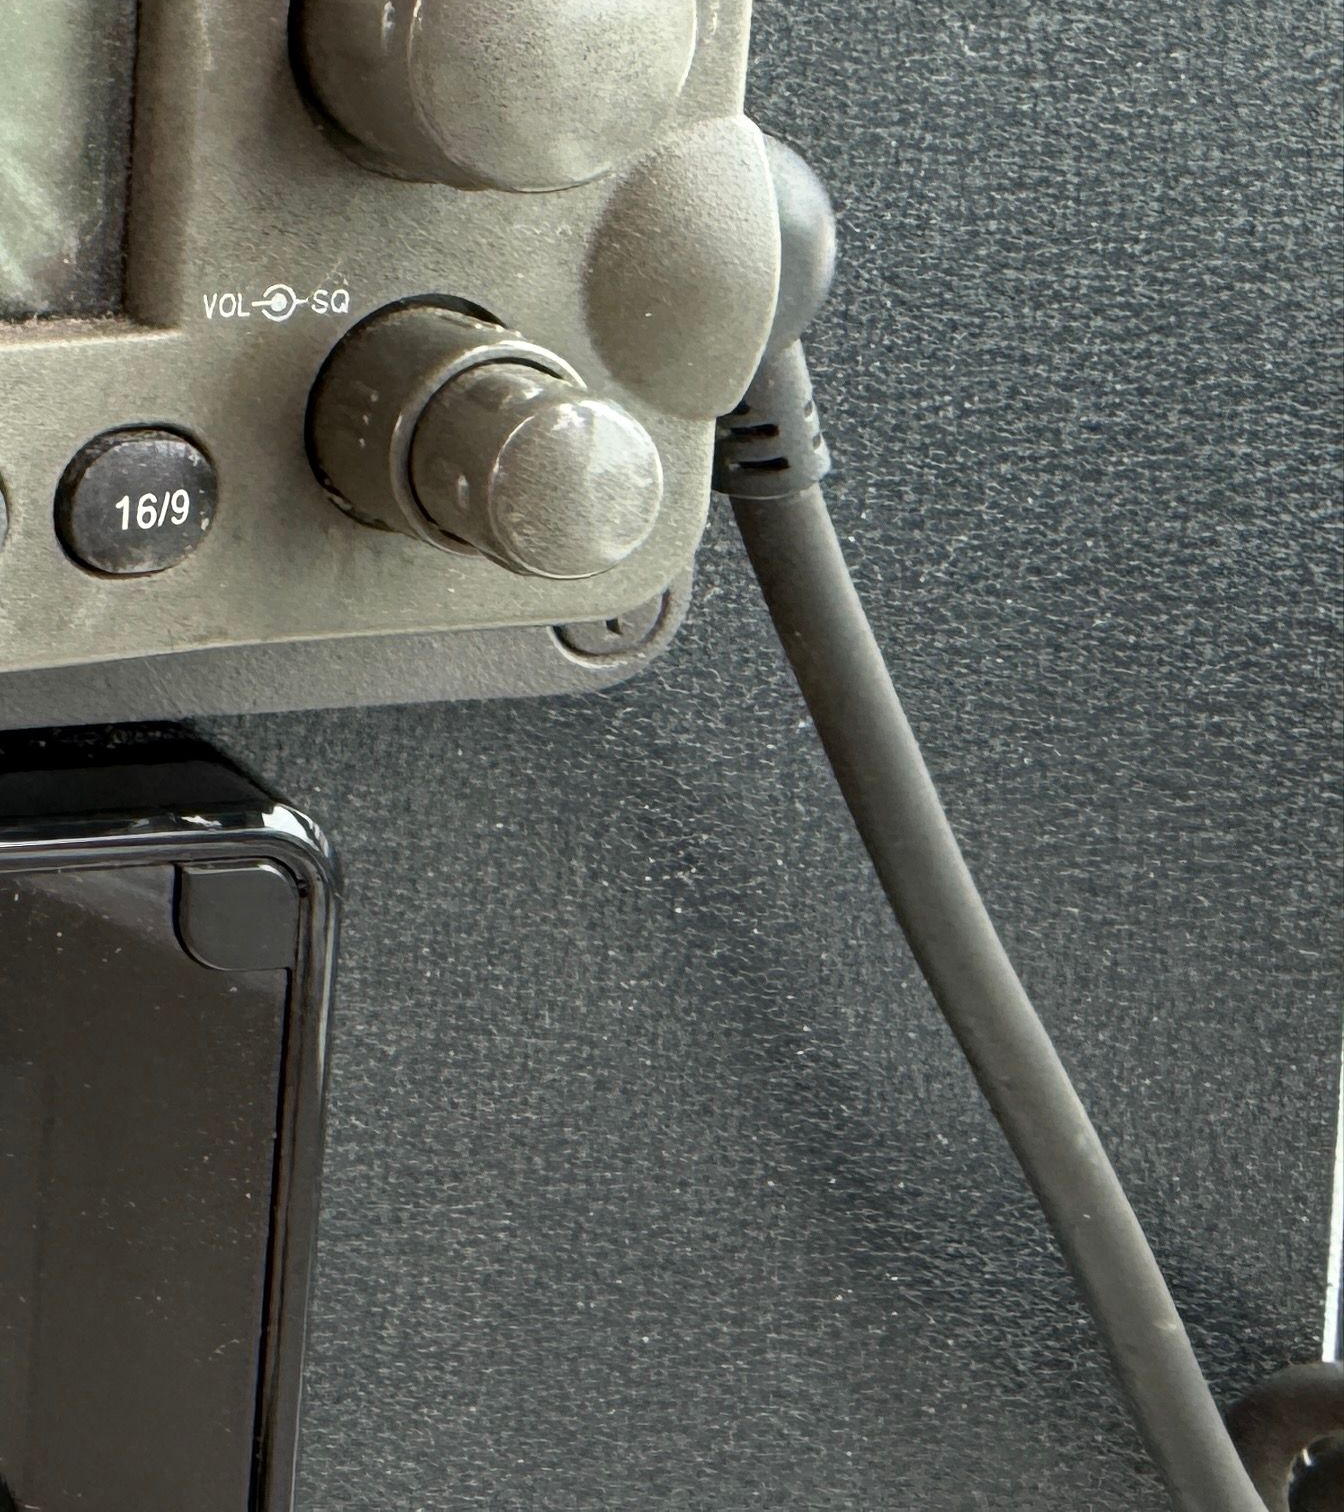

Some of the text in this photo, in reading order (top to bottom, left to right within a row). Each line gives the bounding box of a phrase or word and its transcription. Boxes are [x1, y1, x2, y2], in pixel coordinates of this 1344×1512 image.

[202, 288, 351, 320] VOL SQ
[114, 489, 191, 530] 16/9
